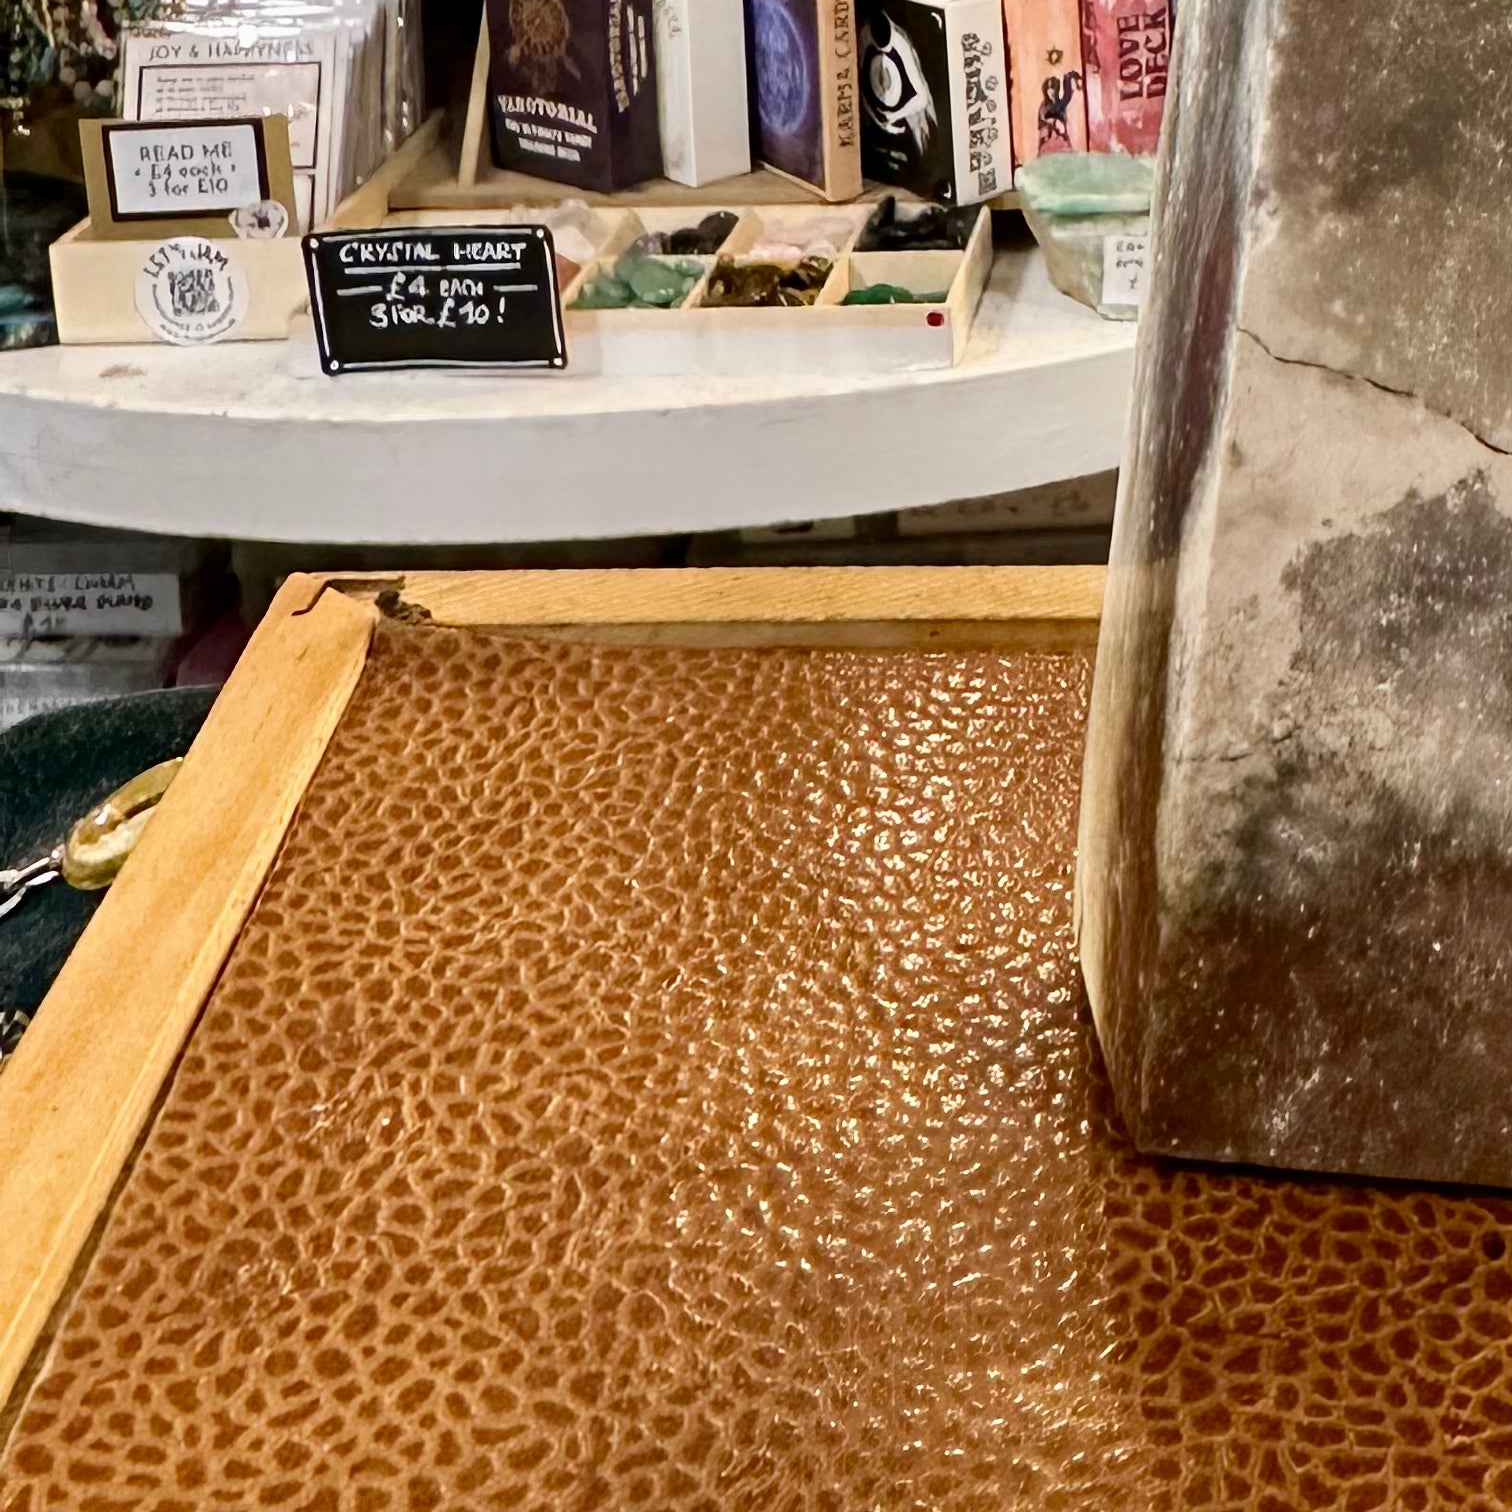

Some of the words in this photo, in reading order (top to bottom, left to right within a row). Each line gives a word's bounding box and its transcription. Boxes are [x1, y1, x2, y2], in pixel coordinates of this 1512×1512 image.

[150, 44, 182, 61] JOY
[1117, 15, 1144, 102] LOVE
[1144, 7, 1167, 100] DECK
[140, 144, 194, 162] READ
[203, 141, 232, 159] ME
[165, 180, 190, 196] for
[198, 178, 228, 195] £10
[339, 241, 440, 264] CRYSTAL
[453, 241, 527, 261] HEART
[385, 271, 430, 302] £4
[369, 303, 389, 329] 3
[391, 303, 436, 325] FOR
